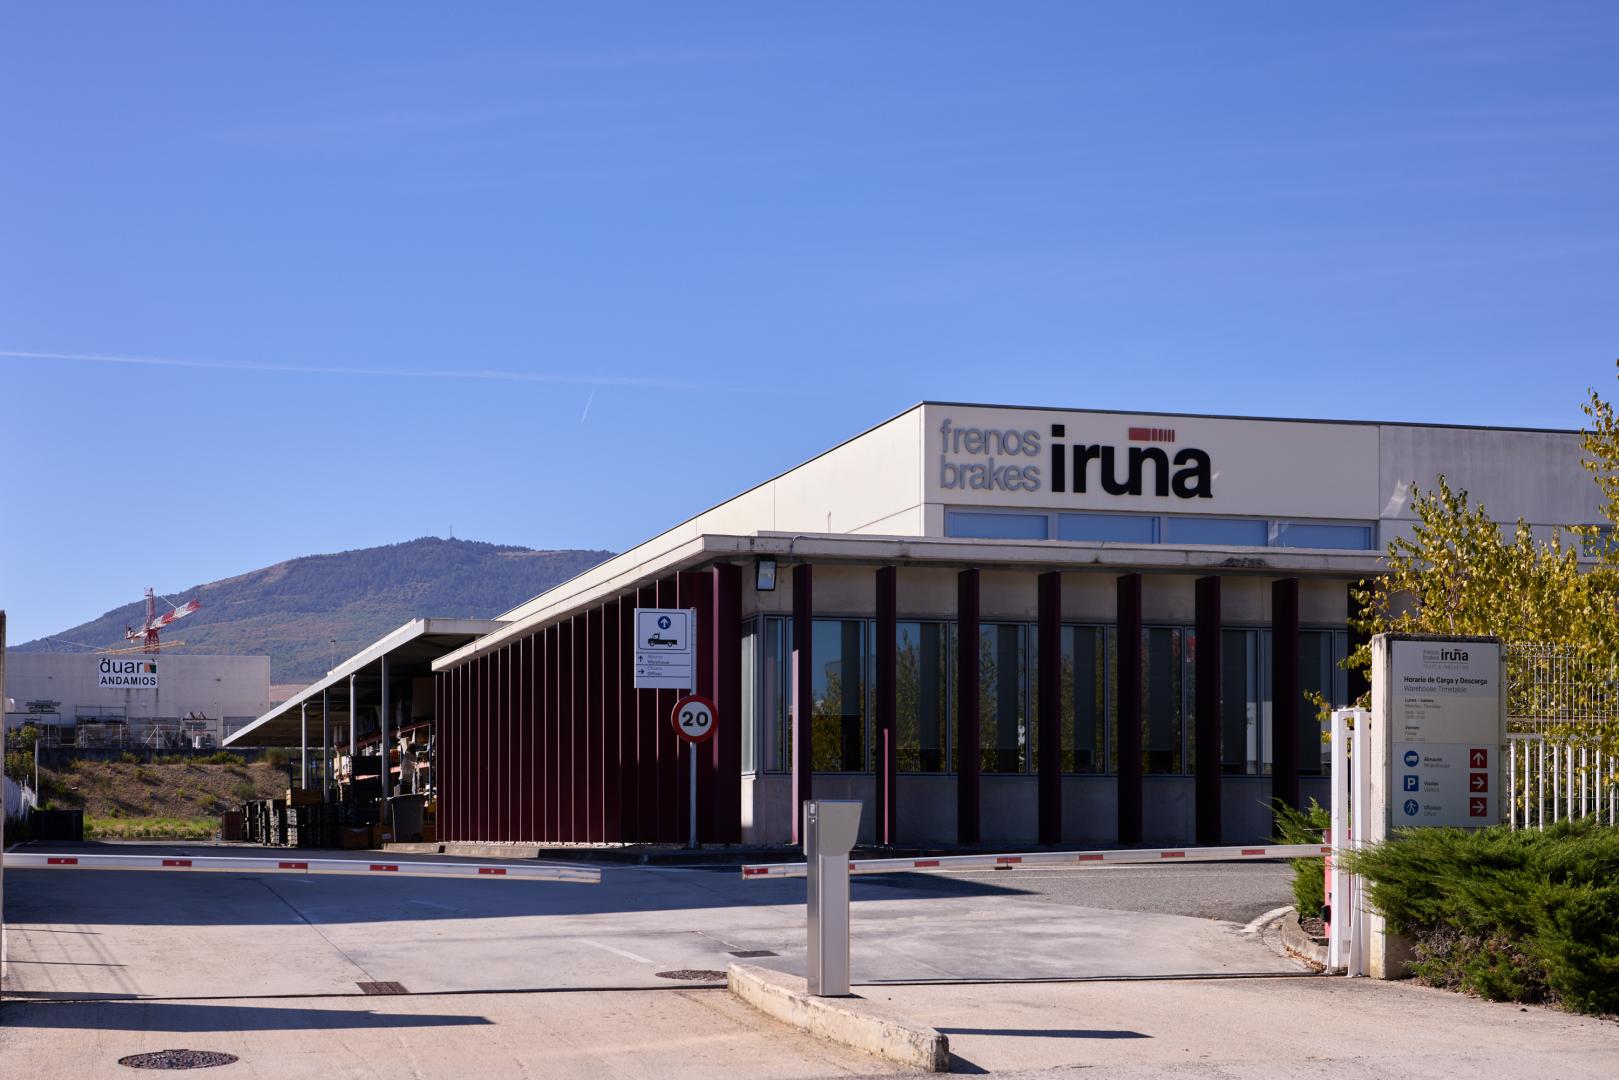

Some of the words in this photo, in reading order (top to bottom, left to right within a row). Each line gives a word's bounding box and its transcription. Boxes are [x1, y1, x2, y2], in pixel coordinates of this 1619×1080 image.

[939, 418, 1041, 456] frenos
[939, 454, 1041, 492] brakes
[100, 676, 157, 686] ANDAMIOS
[1436, 677, 1454, 685] Carga
[1460, 678, 1488, 686] Descarga
[1404, 685, 1437, 693] Warehouse
[682, 711, 709, 727] 20
